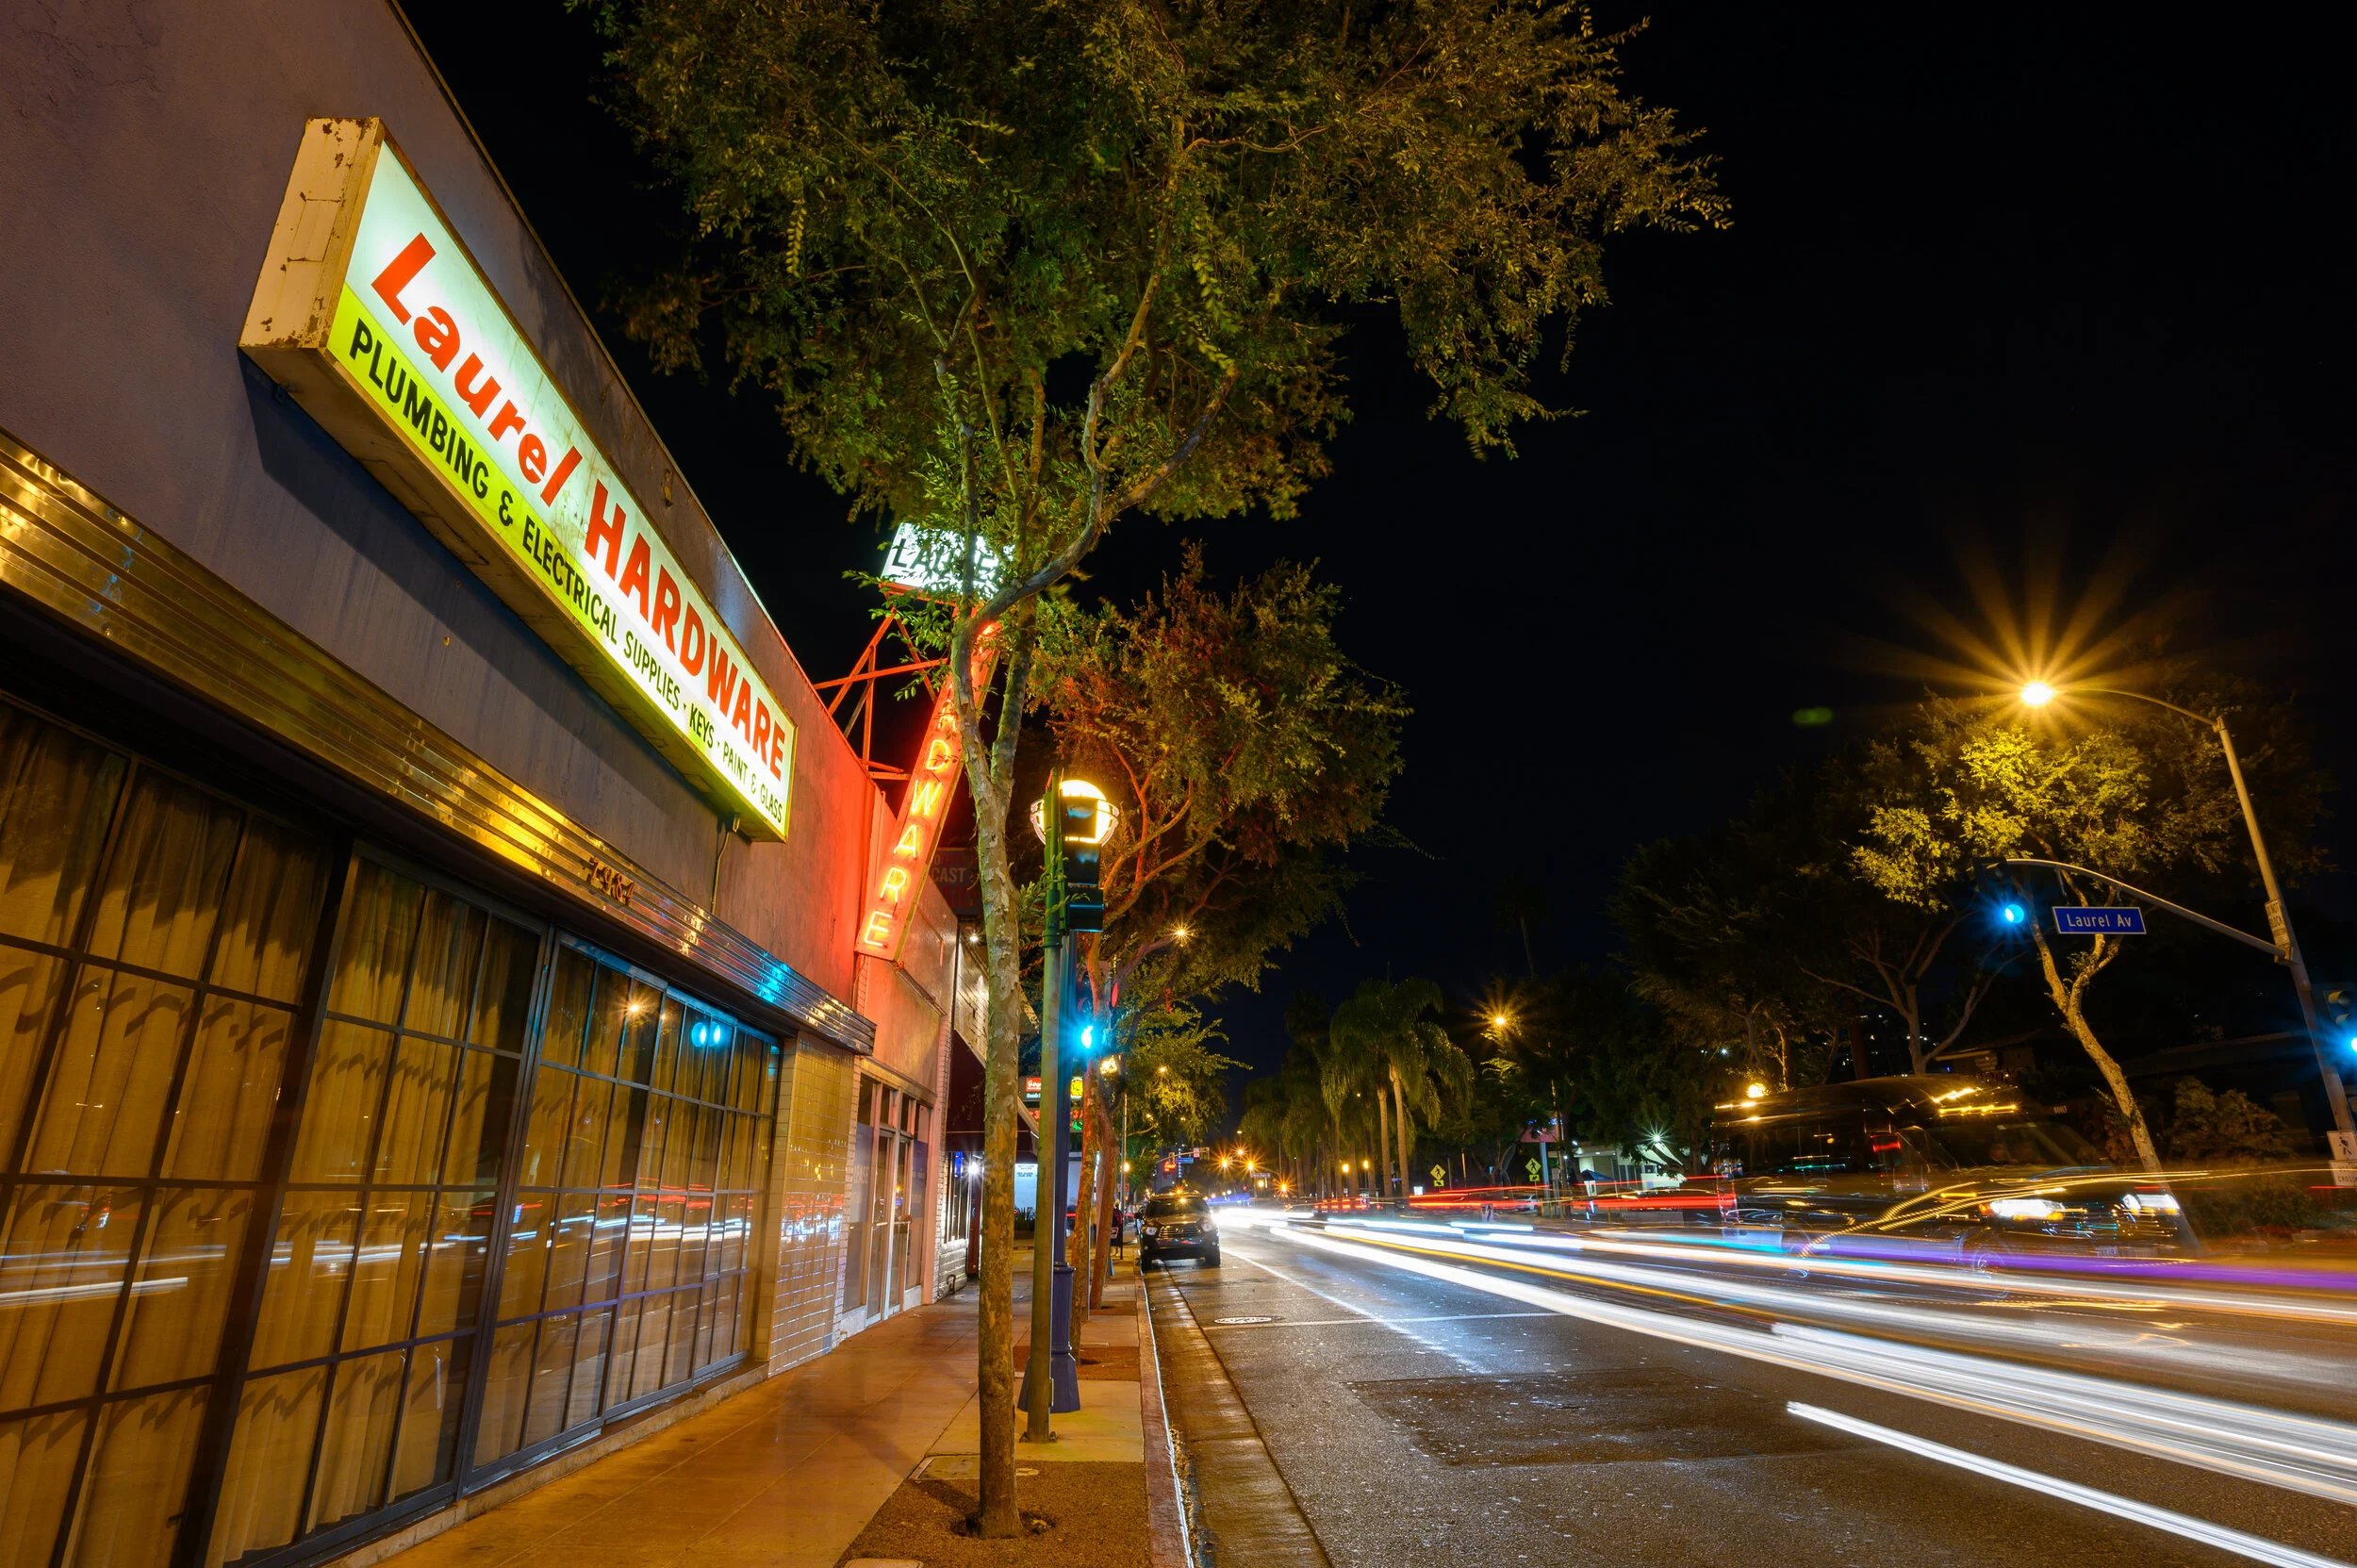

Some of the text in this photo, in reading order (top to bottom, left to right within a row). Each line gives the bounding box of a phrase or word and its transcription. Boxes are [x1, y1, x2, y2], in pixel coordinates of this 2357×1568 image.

[350, 318, 783, 823] PLUMBING & ELECTRICAL SUPPLIES KEYS PAINT & GLASS
[371, 232, 785, 782] Laurel HARDWARE
[587, 855, 635, 907] 7984
[2066, 914, 2132, 928] Laurel Av
